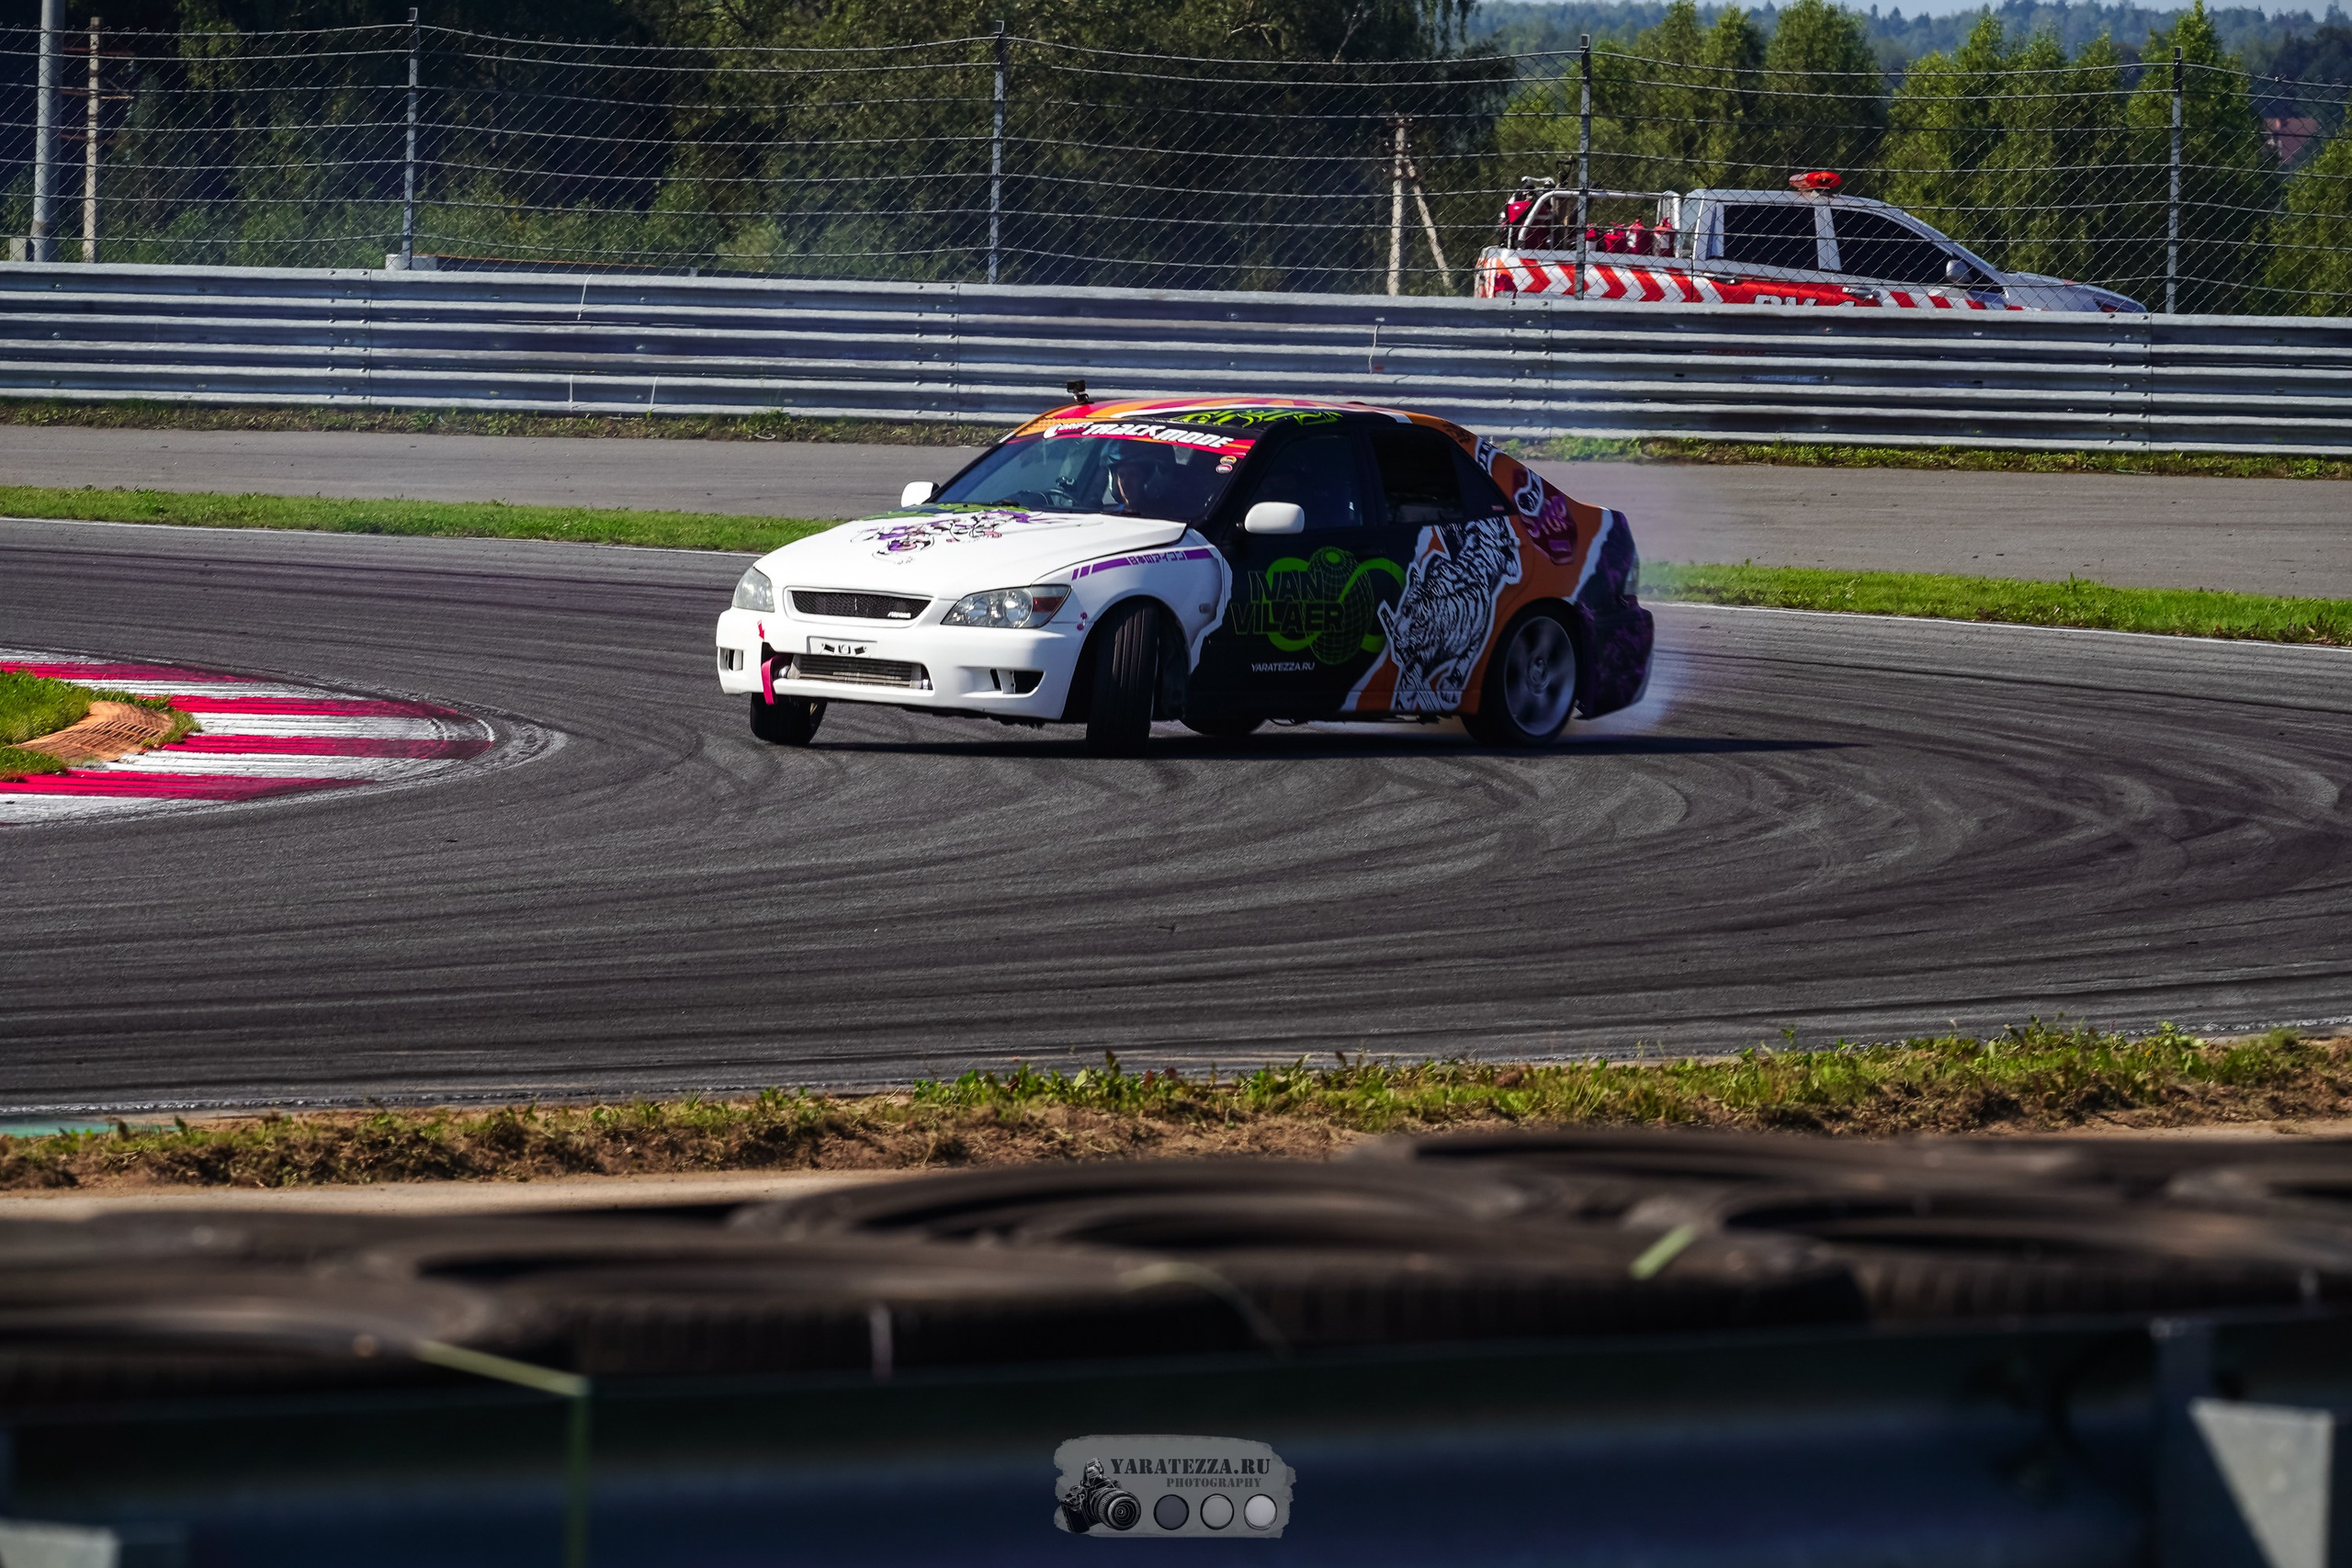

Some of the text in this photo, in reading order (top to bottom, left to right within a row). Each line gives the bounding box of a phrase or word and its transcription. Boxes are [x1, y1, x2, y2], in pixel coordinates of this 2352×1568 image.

[1248, 570, 1324, 603] IVAN
[1229, 601, 1345, 635] VILAER
[1250, 661, 1316, 672] YARATEZZA.RU
